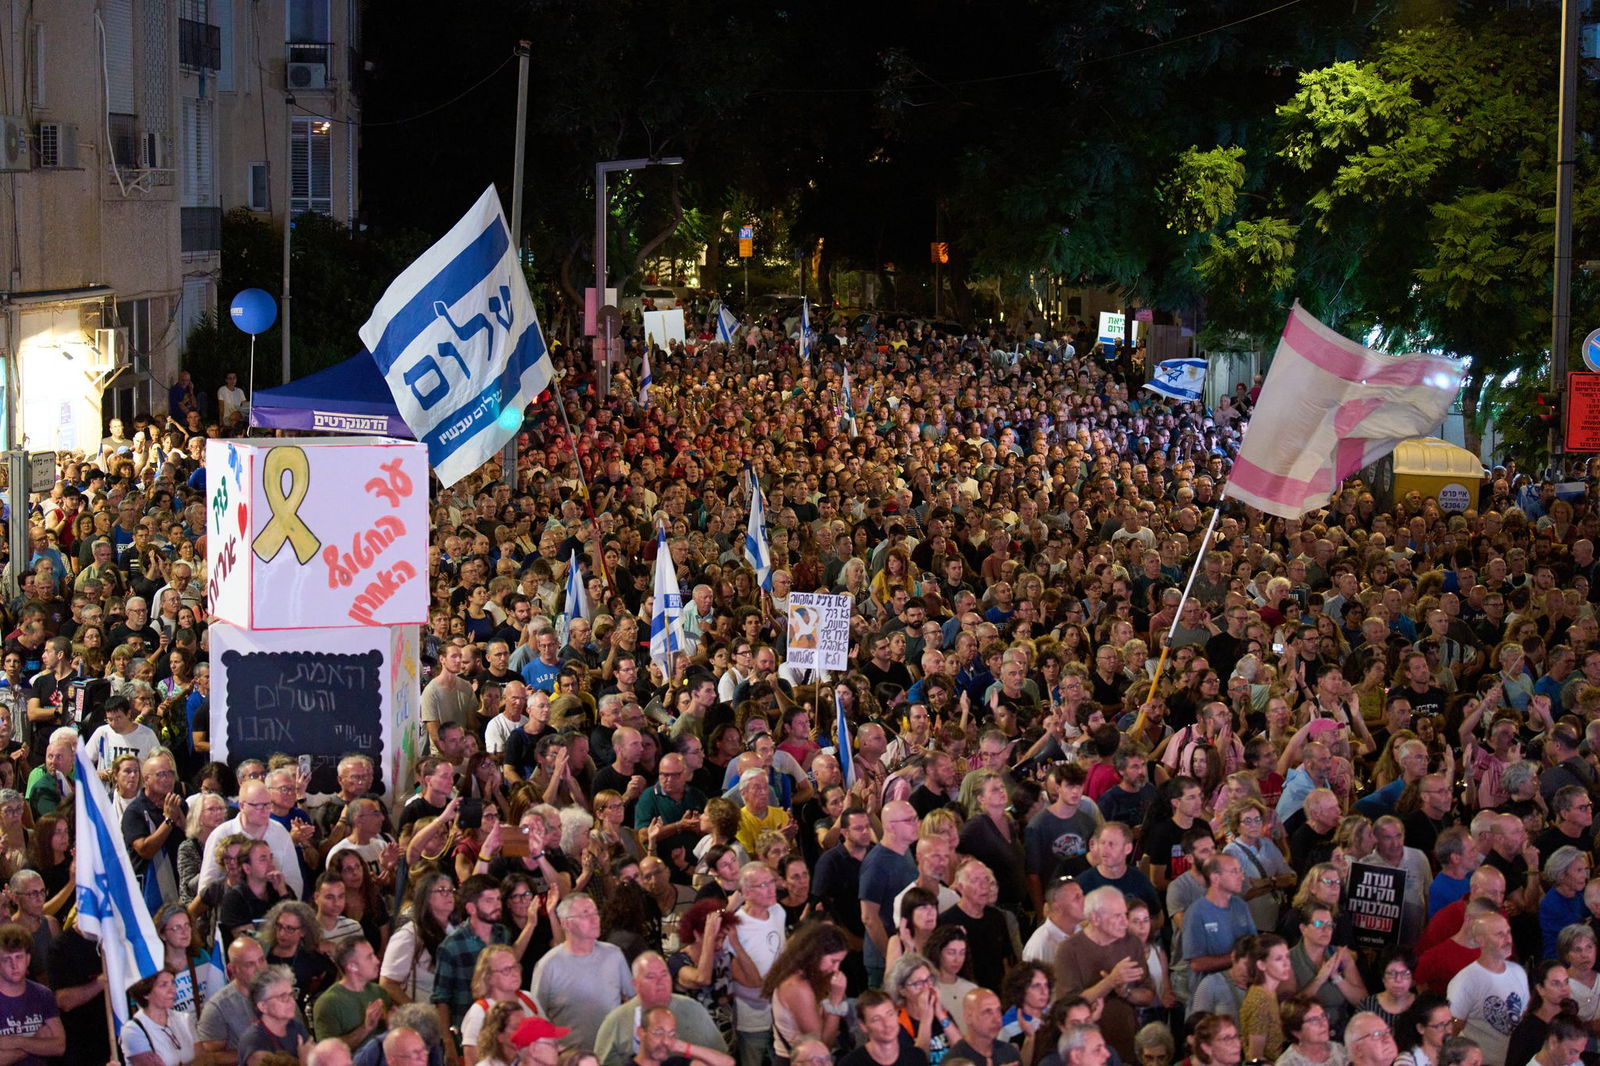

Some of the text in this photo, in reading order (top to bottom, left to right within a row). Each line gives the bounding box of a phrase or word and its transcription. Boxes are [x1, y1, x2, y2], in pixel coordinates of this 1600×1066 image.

[1108, 325, 1124, 333] ירום
[403, 277, 514, 411] שלום
[314, 415, 388, 430] הדמוקרטים
[438, 388, 502, 445] שלום עכשיו
[365, 458, 413, 507] עד
[322, 515, 407, 589] החטוף
[348, 560, 418, 626] האחרון
[840, 608, 850, 620] לא
[824, 652, 840, 665] ולא
[287, 662, 365, 690] האמת
[254, 672, 336, 712] והשלום
[237, 716, 294, 744] אהבו
[1362, 872, 1394, 888] ועדת
[1356, 884, 1396, 903] חקירה
[1348, 898, 1400, 919] ממלכתית
[1352, 912, 1394, 932] עכשיו
